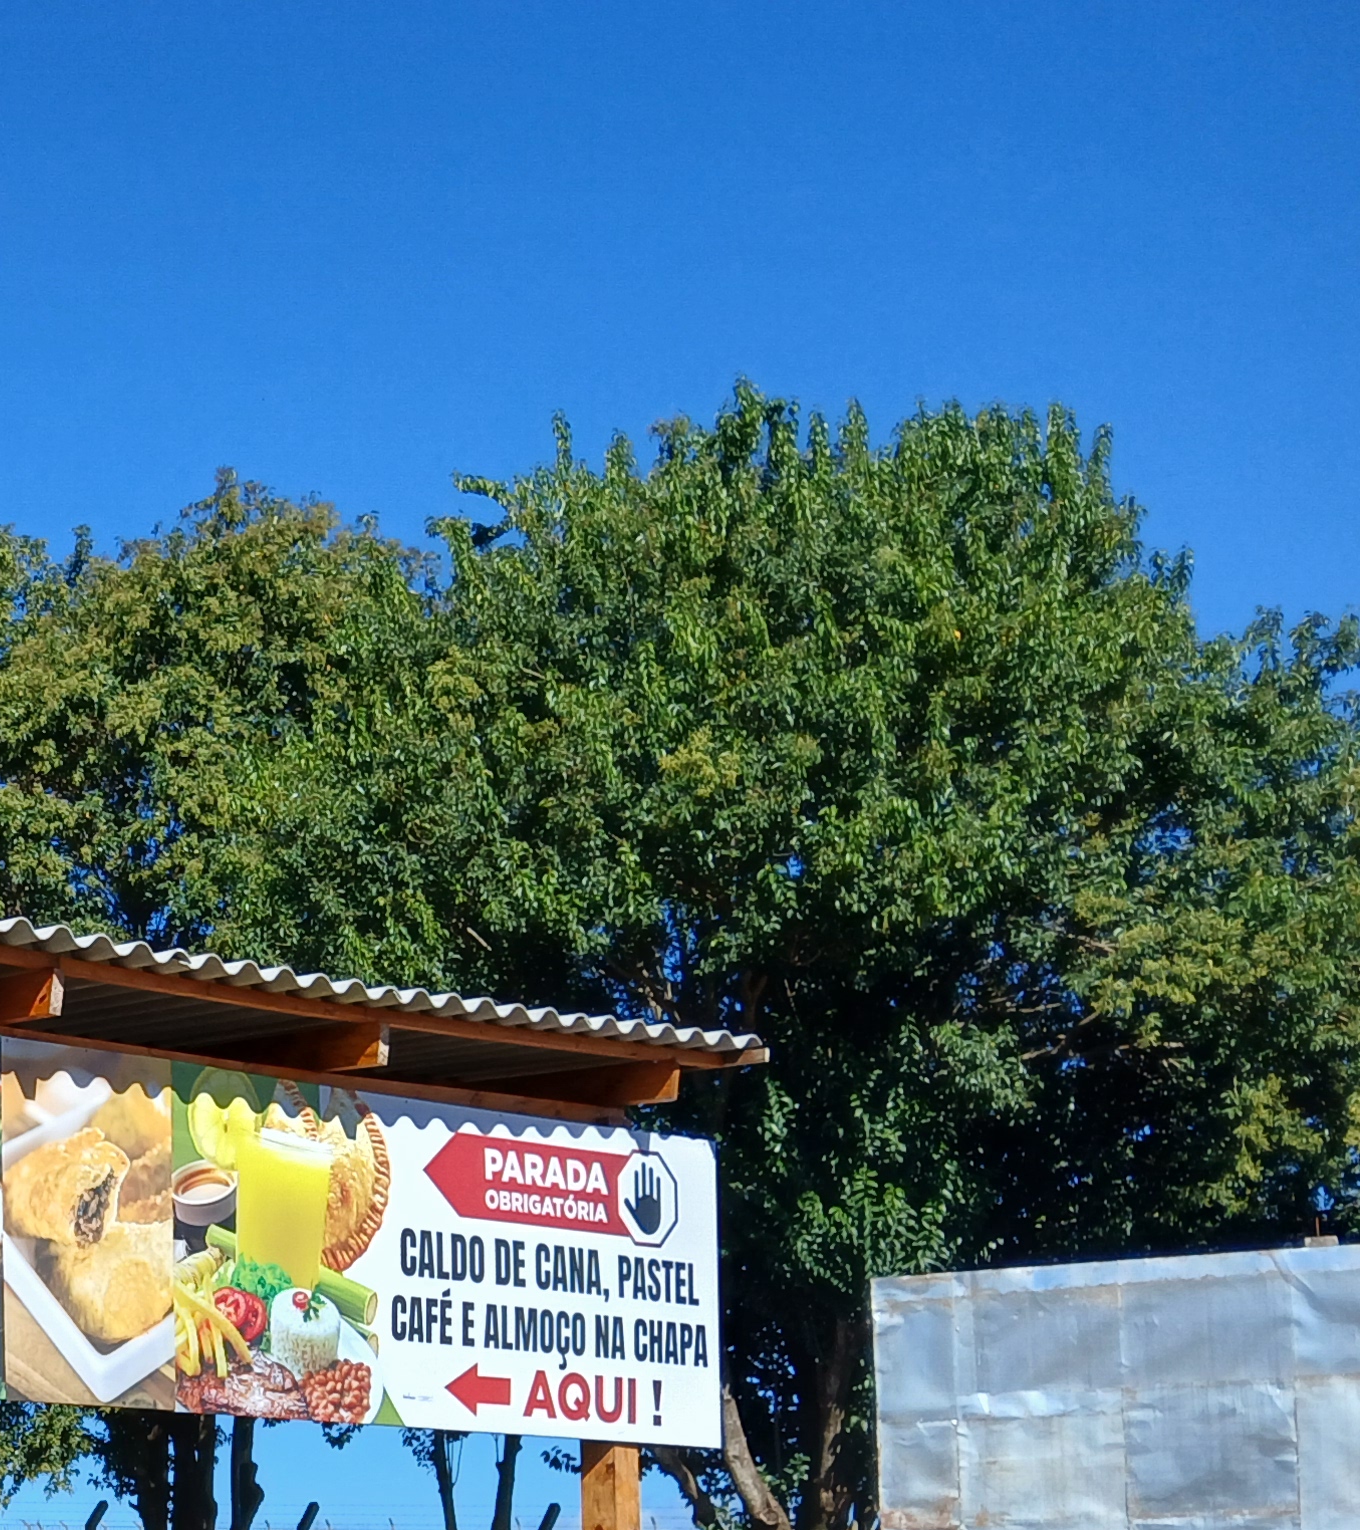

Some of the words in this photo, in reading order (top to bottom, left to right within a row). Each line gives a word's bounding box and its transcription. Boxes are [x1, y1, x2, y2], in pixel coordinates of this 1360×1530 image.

[484, 1147, 609, 1196] PARADA
[485, 1189, 608, 1223] OBRIGATÓRIA
[400, 1228, 485, 1284] CALDO
[494, 1237, 526, 1288] DE
[535, 1242, 610, 1303] CANA,
[617, 1254, 700, 1306] PASTEL
[391, 1288, 453, 1346] CAFÉ
[461, 1301, 475, 1347] E
[484, 1303, 586, 1370] ALMOÇO
[595, 1314, 626, 1360] NA
[633, 1318, 709, 1368] CHAPA
[522, 1370, 636, 1425] AQUI
